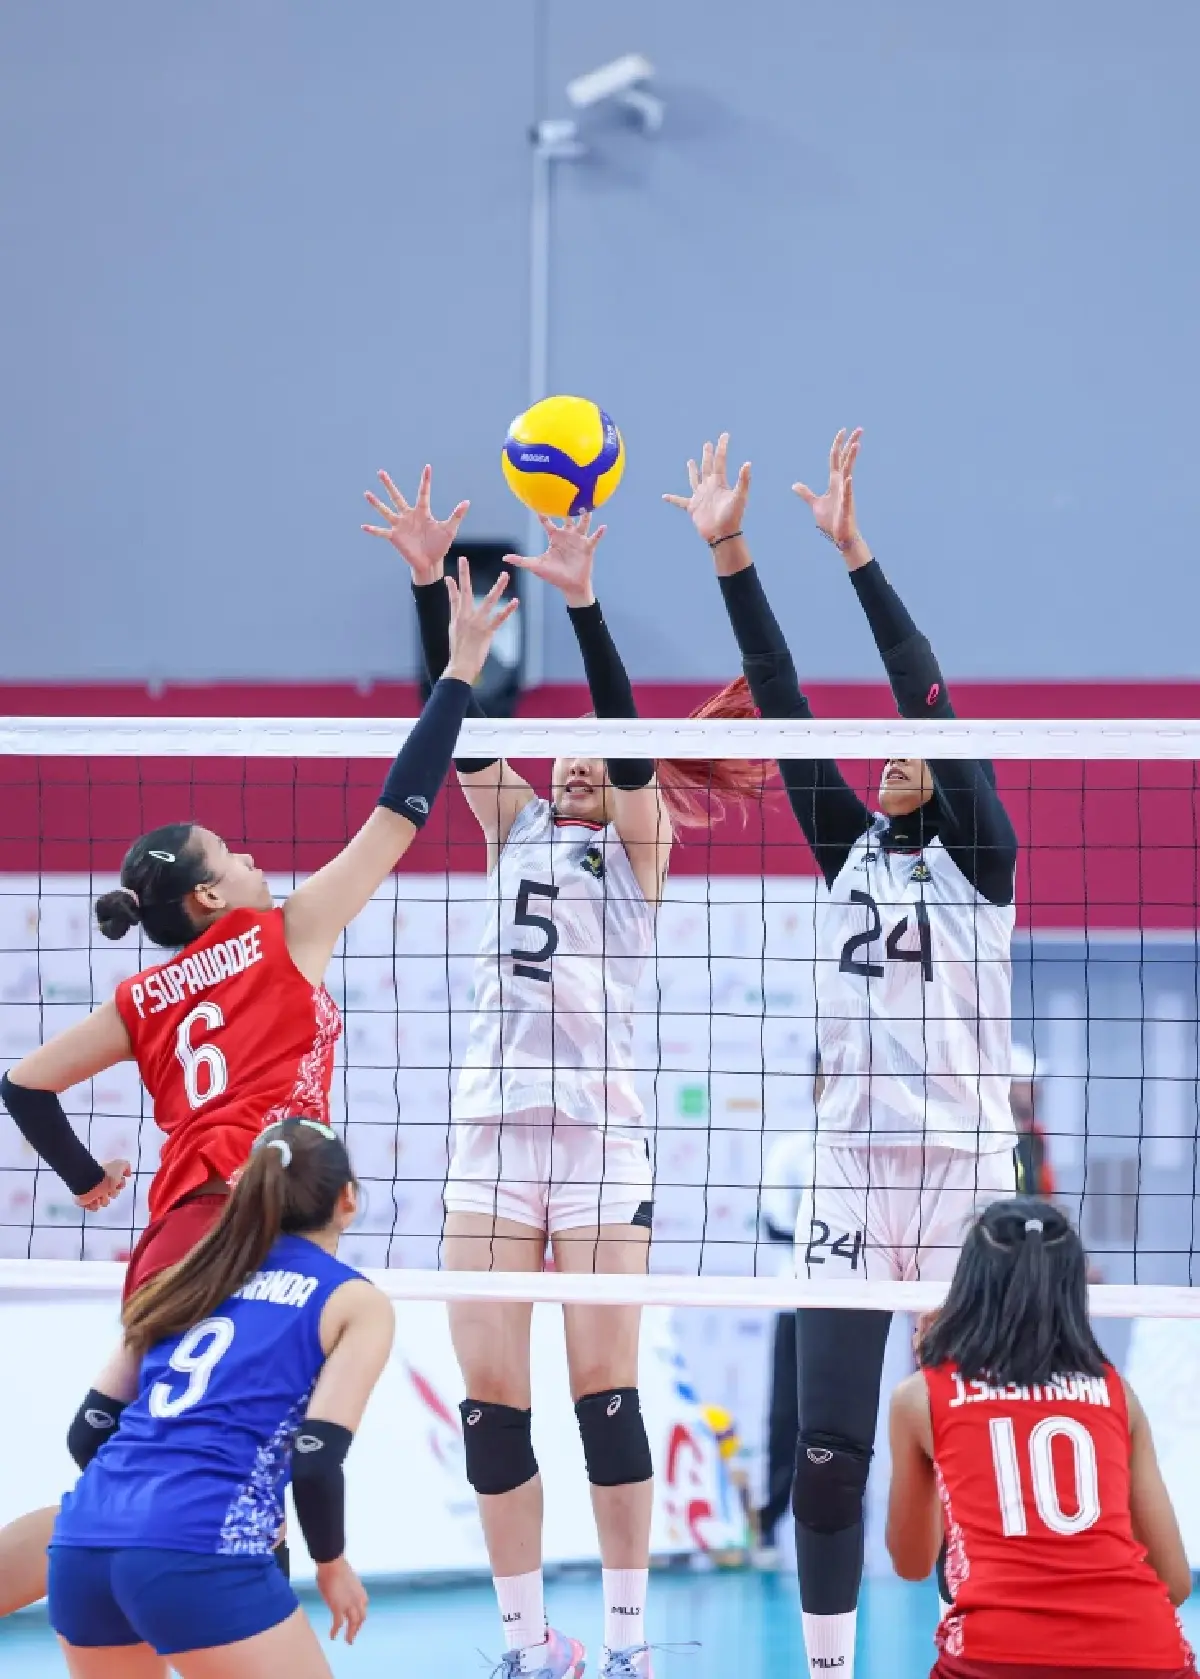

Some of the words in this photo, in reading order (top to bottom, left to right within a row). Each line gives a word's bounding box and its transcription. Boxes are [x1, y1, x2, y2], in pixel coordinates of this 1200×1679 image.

[511, 878, 560, 962] 5
[839, 888, 934, 982] 24
[174, 1001, 228, 1110] 6
[804, 1219, 862, 1270] 24
[148, 1316, 235, 1418] 9
[989, 1416, 1101, 1537] 10
[811, 1655, 845, 1669] MILLS
